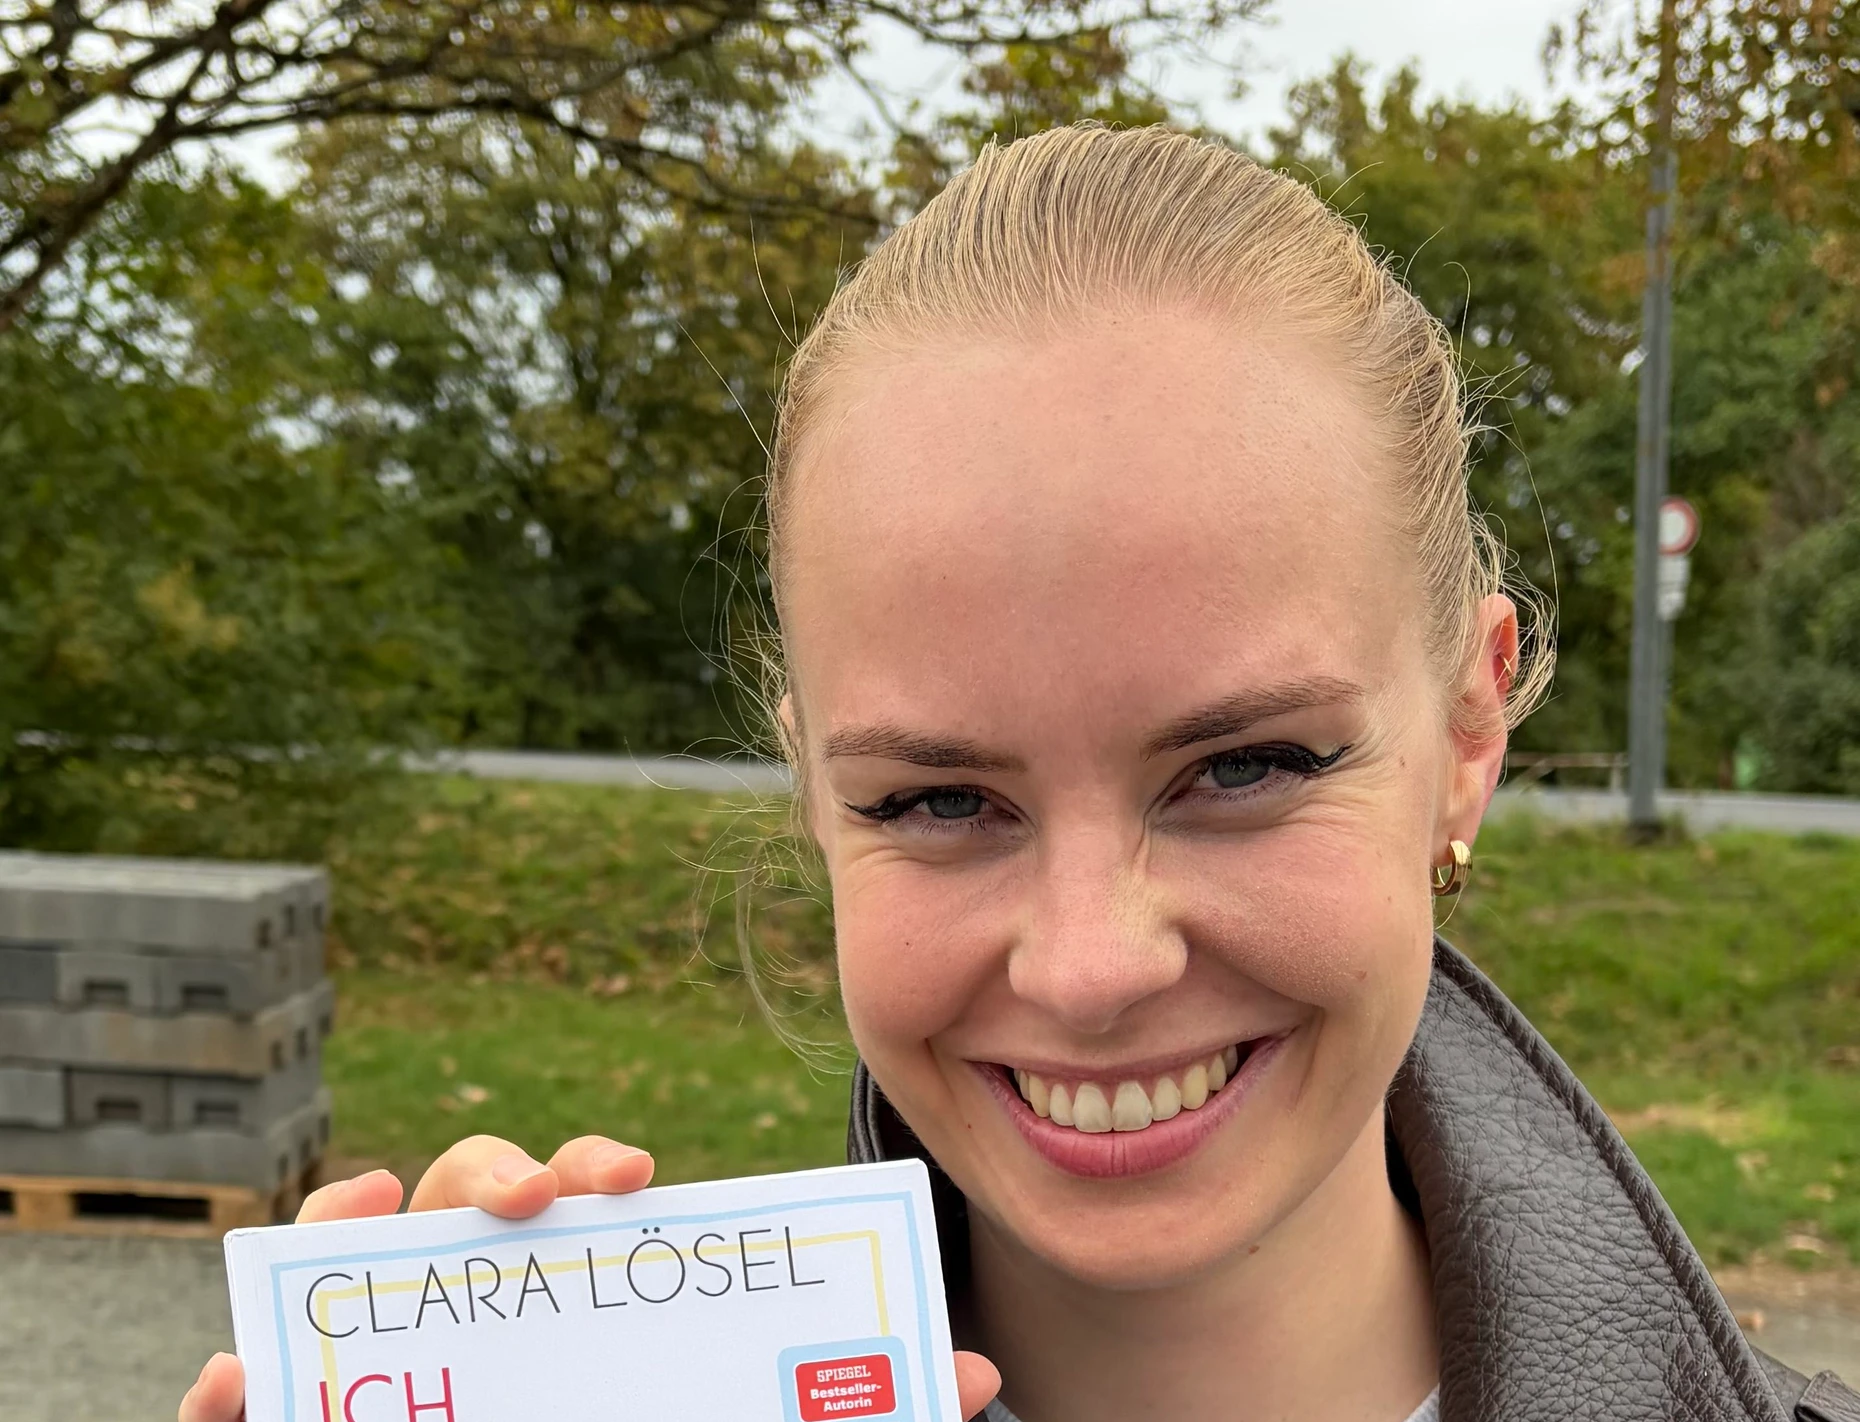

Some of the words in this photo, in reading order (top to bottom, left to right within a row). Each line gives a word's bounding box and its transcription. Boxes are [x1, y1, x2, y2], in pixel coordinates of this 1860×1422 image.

[305, 1251, 561, 1339] CLARA
[586, 1225, 826, 1309] LÖSEL
[816, 1364, 872, 1383] SPIEGEL
[810, 1383, 882, 1400] Bestseller-
[823, 1397, 873, 1413] Autorin
